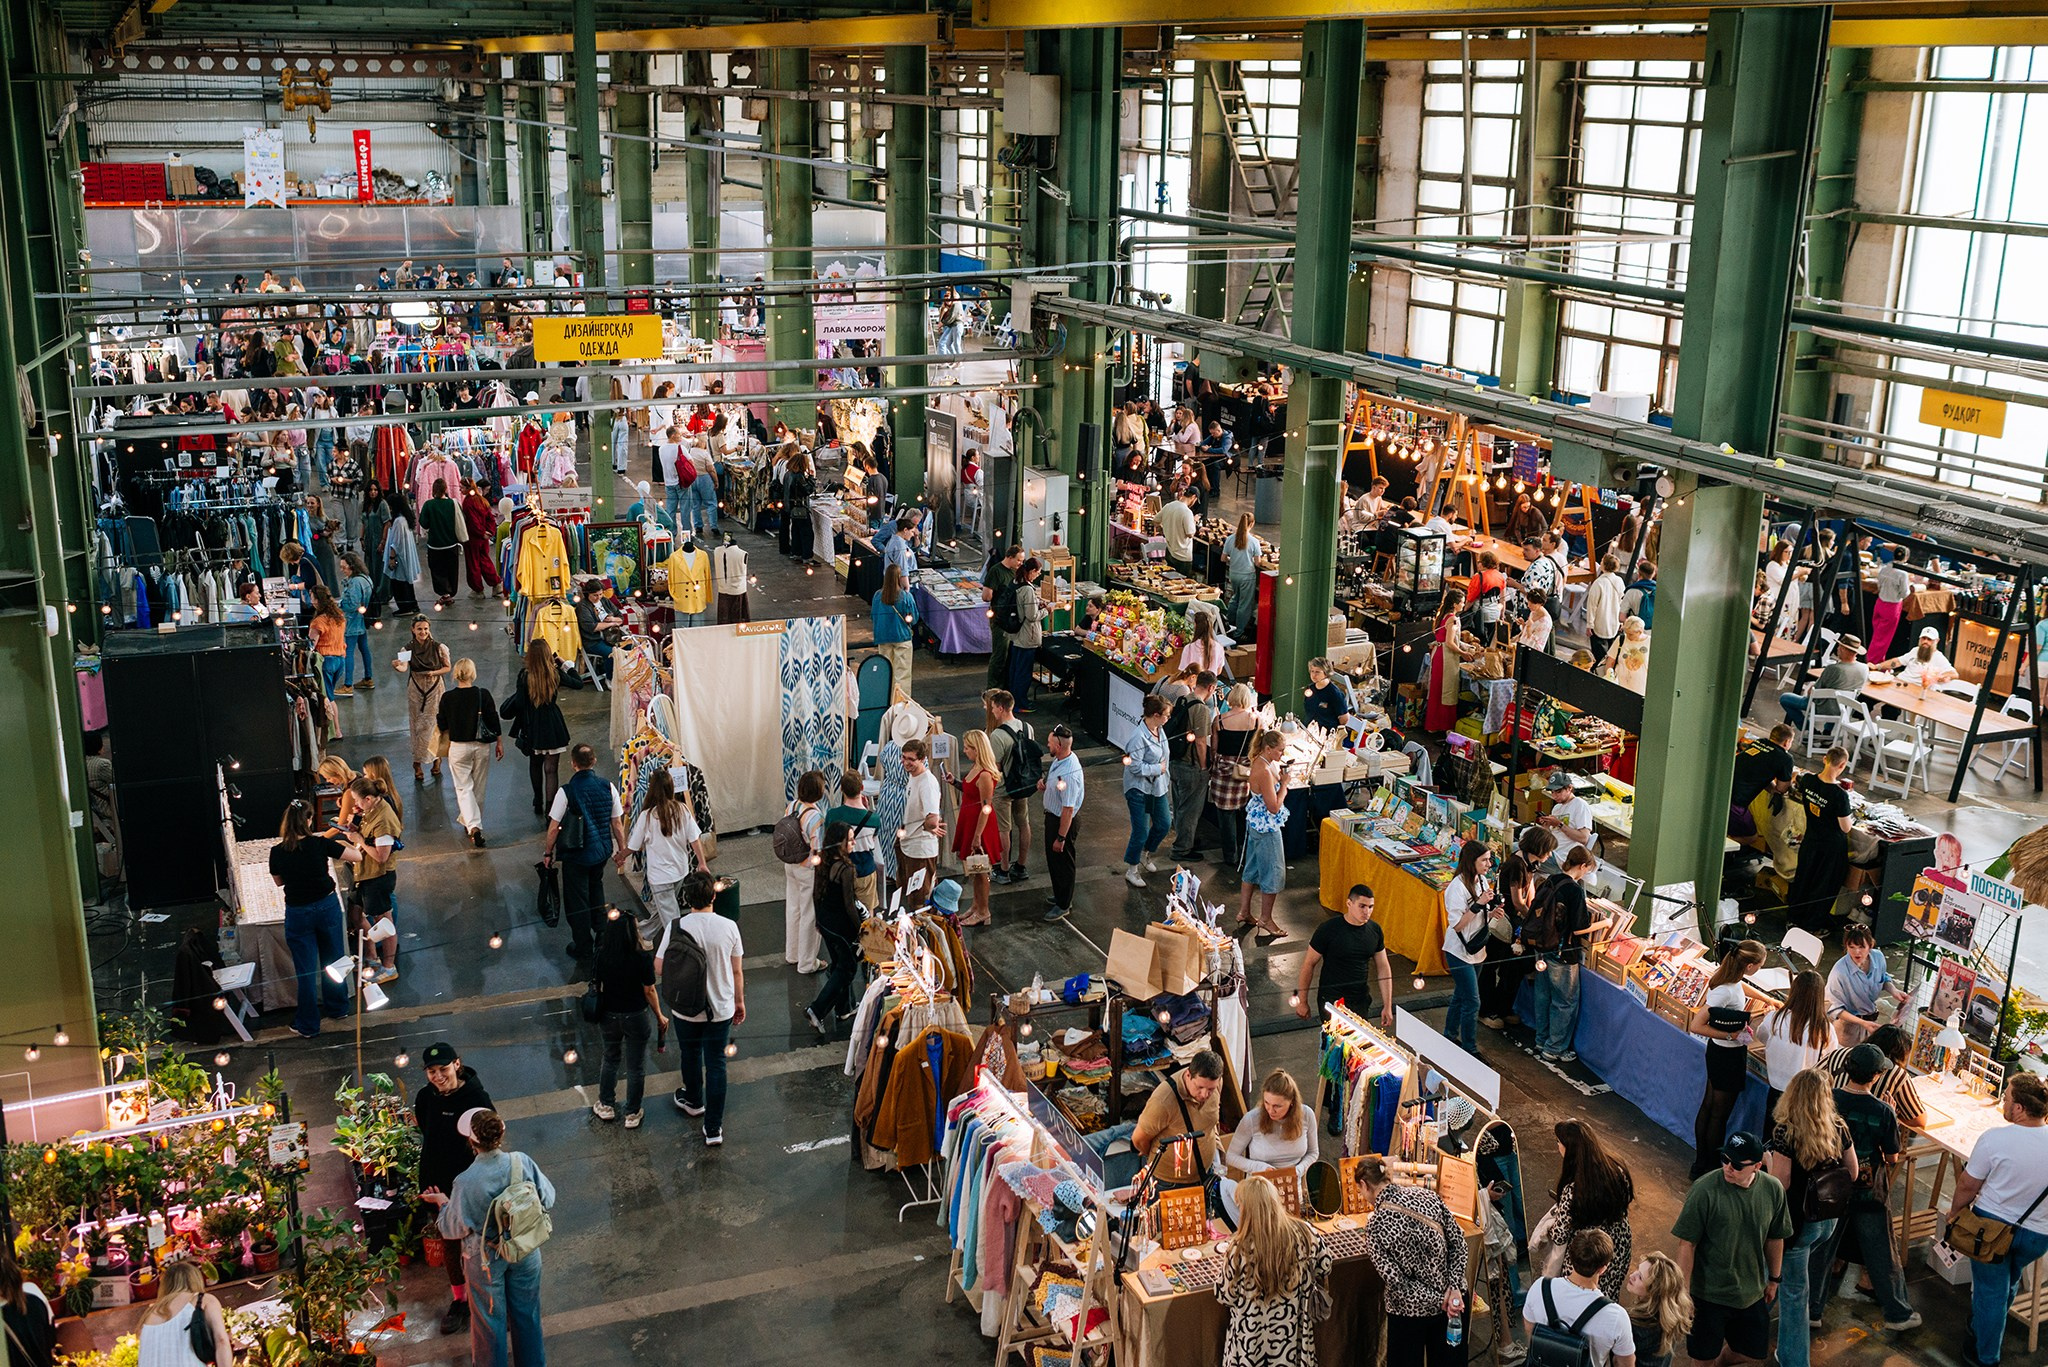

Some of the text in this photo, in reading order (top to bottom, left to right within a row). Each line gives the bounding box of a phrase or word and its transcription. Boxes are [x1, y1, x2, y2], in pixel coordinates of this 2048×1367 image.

[563, 320, 634, 339] ДИЗАЙНЕРСКАЯ
[823, 325, 852, 334] ЛАВКА
[579, 341, 619, 356] ОДЕЖДА
[1942, 403, 1981, 424] ФУДКОРТ
[1966, 640, 2009, 662] ГРУЗИНСЯ
[1973, 657, 1991, 670] ЛАВ
[1971, 874, 2021, 910] ПОСТЕРЫ
[1944, 898, 1967, 912] Sopranos
[1046, 1103, 1083, 1155] MOOD
